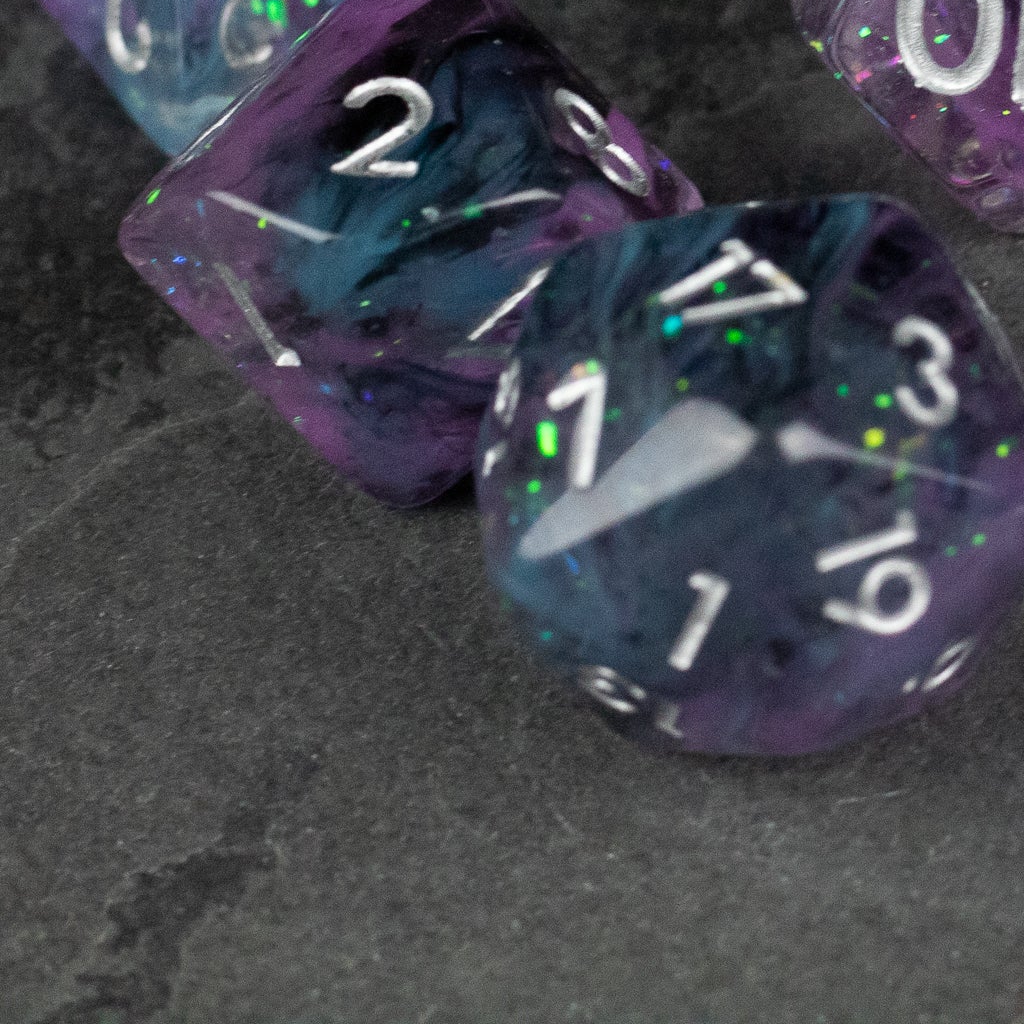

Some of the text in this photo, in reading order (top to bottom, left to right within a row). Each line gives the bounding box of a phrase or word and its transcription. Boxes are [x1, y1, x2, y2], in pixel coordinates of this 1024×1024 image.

[331, 75, 434, 177] 2
[554, 86, 652, 198] 8
[657, 238, 808, 324] 17
[895, 314, 958, 427] 3
[668, 572, 731, 671] 1
